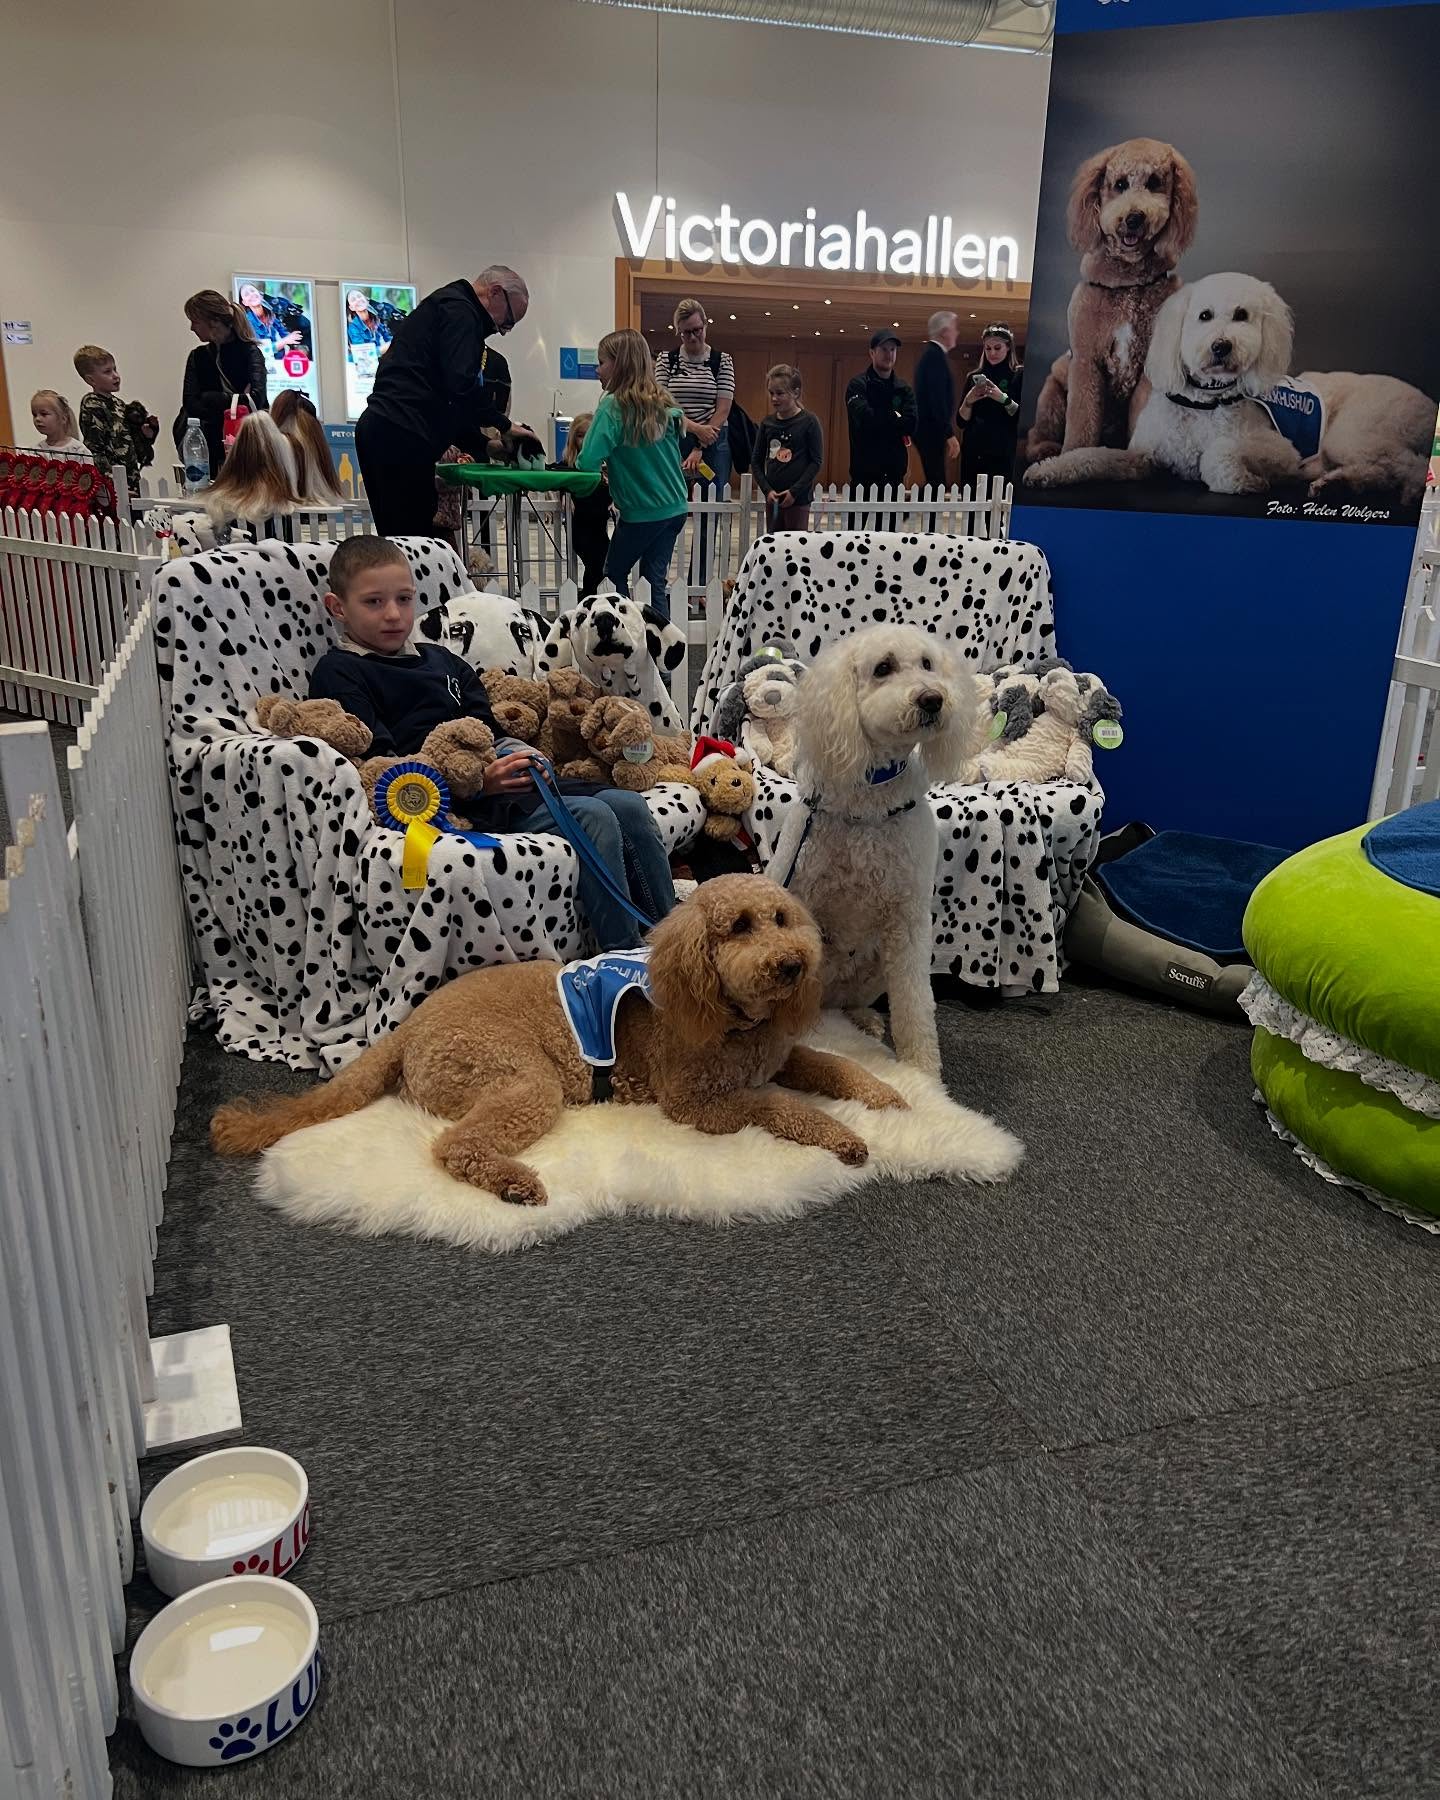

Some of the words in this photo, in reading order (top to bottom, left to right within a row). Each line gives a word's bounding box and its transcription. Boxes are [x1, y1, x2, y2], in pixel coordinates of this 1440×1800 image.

[616, 192, 1018, 279] Victoriahallen
[1267, 501, 1298, 515] Foto:
[1303, 502, 1337, 516] Helen
[1342, 505, 1390, 521] Wolgers
